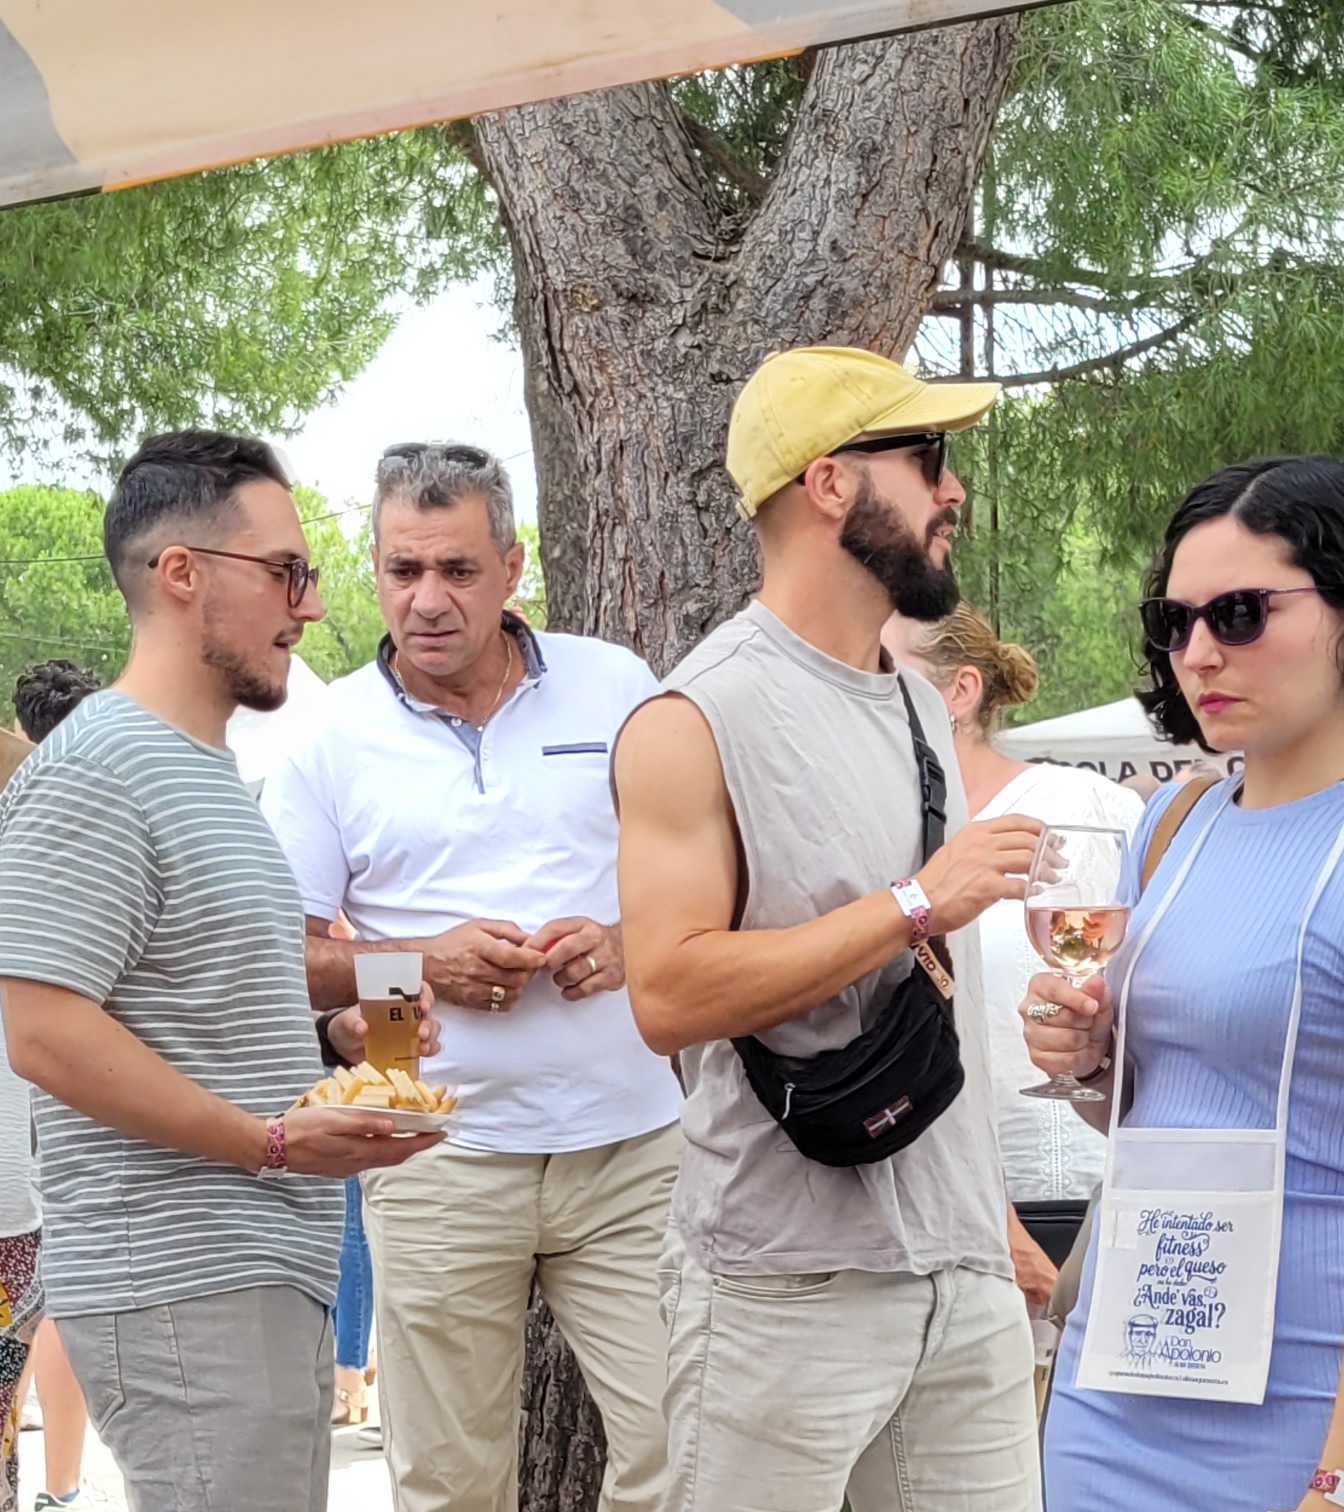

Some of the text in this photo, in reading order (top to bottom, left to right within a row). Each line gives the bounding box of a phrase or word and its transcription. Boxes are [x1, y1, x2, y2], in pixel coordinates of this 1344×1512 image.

[1137, 1208, 1234, 1235] He intentado ser
[1155, 1232, 1205, 1261] fitness
[1136, 1262, 1169, 1282] pero
[1169, 1257, 1186, 1278] el
[1184, 1260, 1228, 1283] queso
[1164, 1302, 1227, 1335] zagal?
